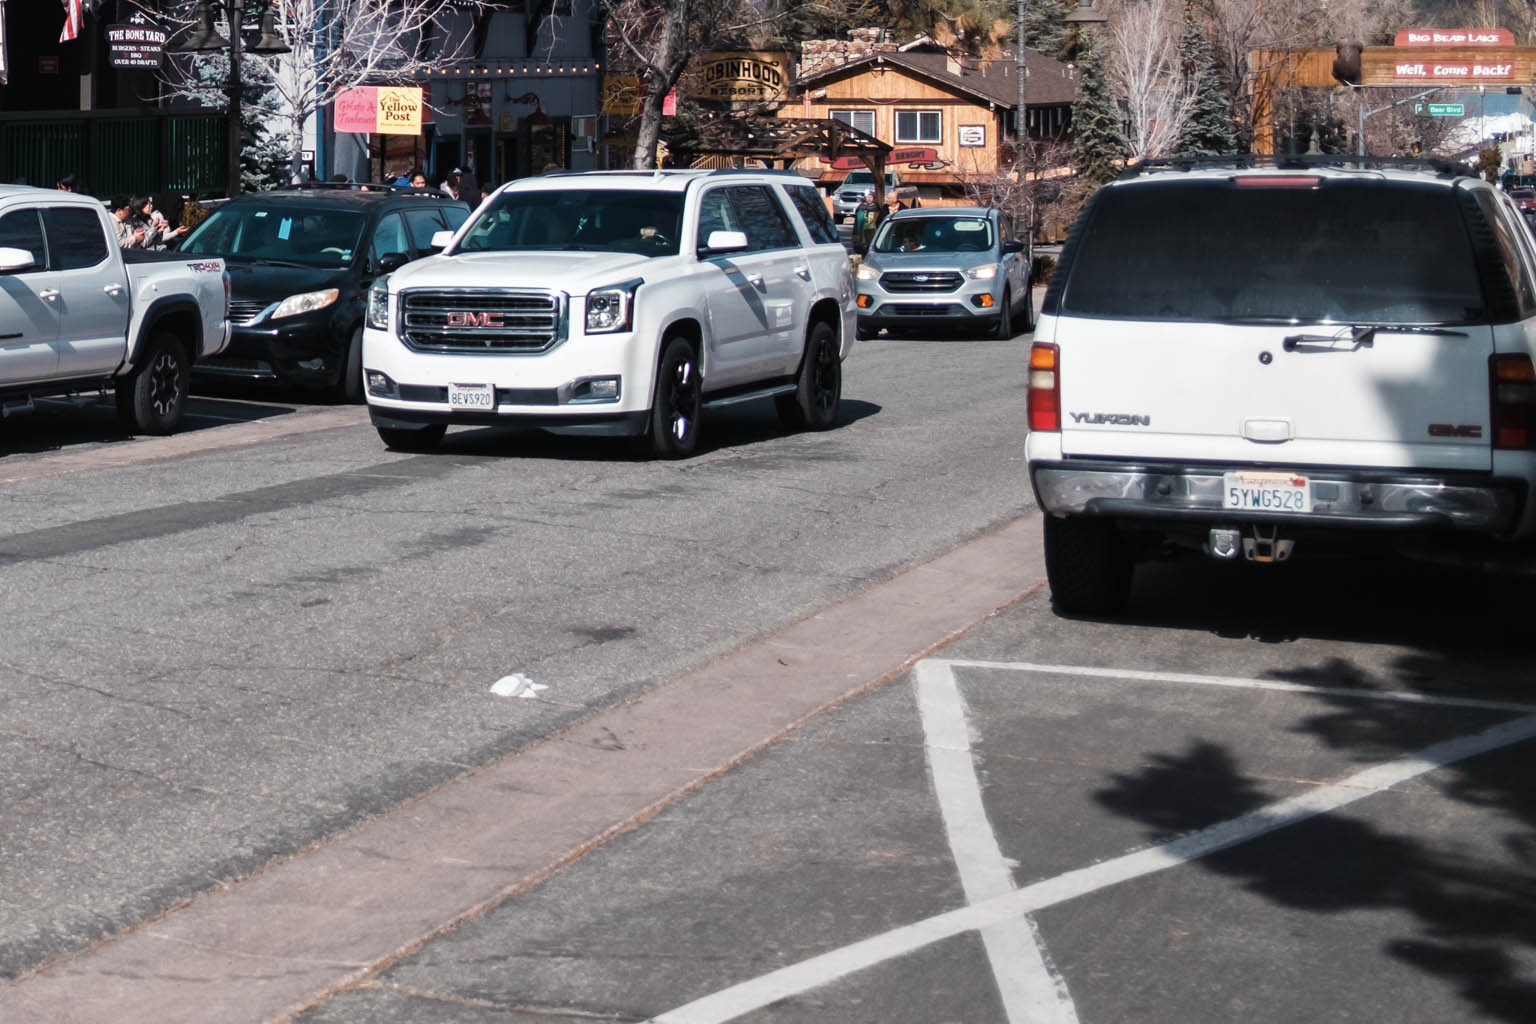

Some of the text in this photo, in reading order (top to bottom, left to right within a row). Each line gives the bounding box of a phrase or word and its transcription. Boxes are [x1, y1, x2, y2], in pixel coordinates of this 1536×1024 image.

[109, 29, 166, 43] THE BONE YARD
[1408, 33, 1500, 43] BIG BEAR LAKE
[706, 61, 780, 86] OBINHOOD
[1433, 65, 1469, 76] Come
[1473, 64, 1512, 76] Back!
[710, 87, 765, 96] RESORT
[379, 101, 418, 112] Yellow
[385, 111, 411, 121] Post
[447, 311, 505, 327] GMC
[451, 392, 491, 406] 8EVS920
[1069, 411, 1151, 426] YUKON
[1428, 423, 1482, 438] GMC
[1229, 487, 1305, 509] 5YWG528
